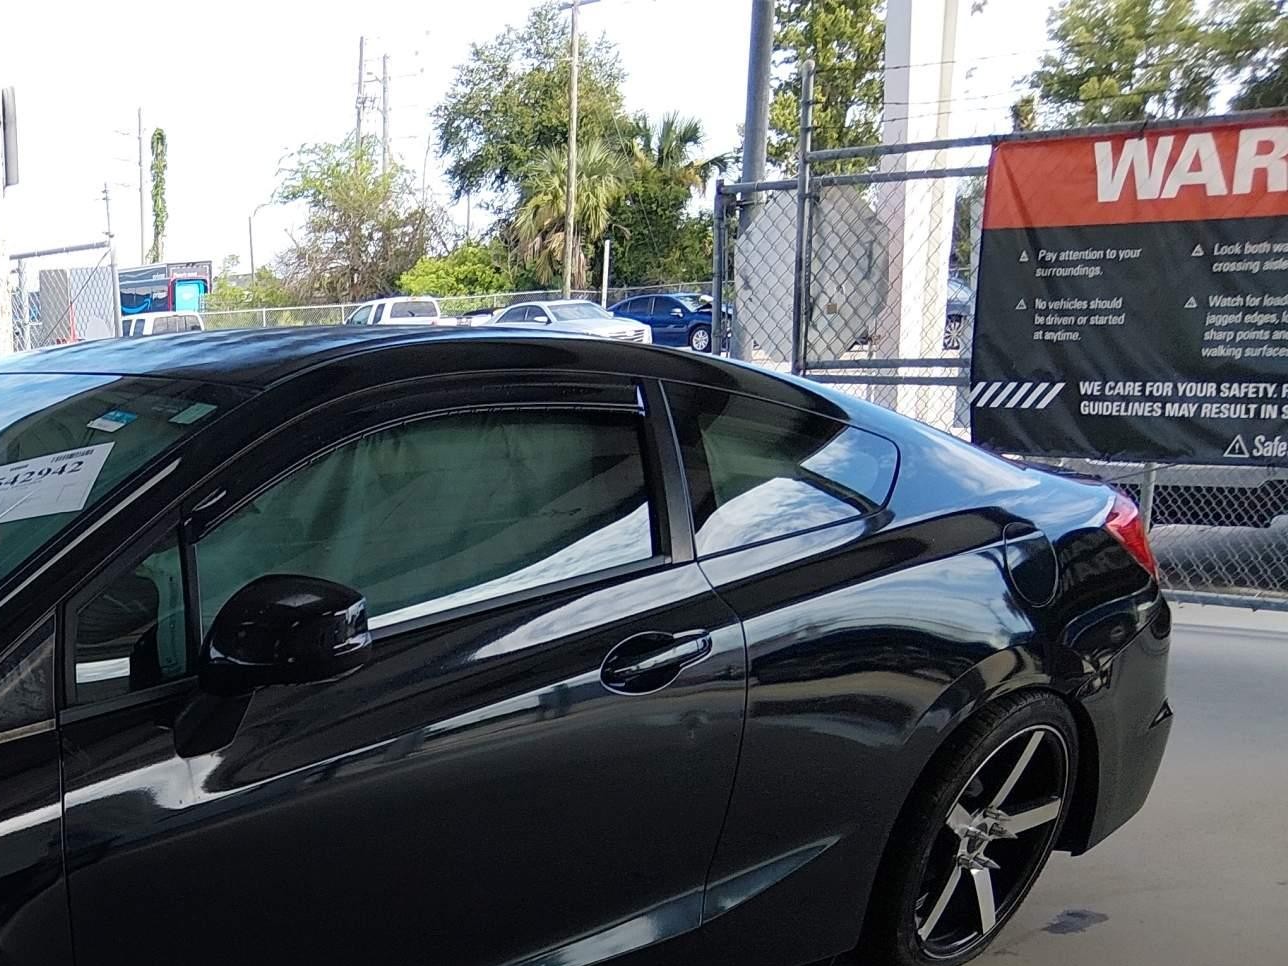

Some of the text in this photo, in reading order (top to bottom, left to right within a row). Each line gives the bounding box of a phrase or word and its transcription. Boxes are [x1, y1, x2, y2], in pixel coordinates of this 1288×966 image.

[1094, 126, 1288, 202] WAR
[1038, 247, 1142, 263] Pay attention to your
[1214, 243, 1242, 256] Look
[1244, 241, 1272, 254] both
[1213, 259, 1261, 273] crossing
[1035, 297, 1123, 309] No vehicles should
[1209, 295, 1244, 307] Watch
[1245, 294, 1262, 307] for
[1034, 313, 1125, 325] be driven or started
[1205, 311, 1242, 327] jagged
[1033, 330, 1043, 340] at
[1203, 328, 1234, 343] sharp
[1235, 327, 1271, 342] points
[1201, 344, 1243, 360] walking
[1080, 381, 1101, 395] WE
[1105, 382, 1142, 396] CARE
[1145, 382, 1173, 397] FOR
[1176, 383, 1216, 397] YOUR
[1219, 383, 1278, 398] SAFETY.
[1080, 401, 1162, 416] GUIDELINES
[1165, 403, 1197, 417] MAY
[1200, 403, 1258, 418] RESULT
[1260, 404, 1278, 419] IN
